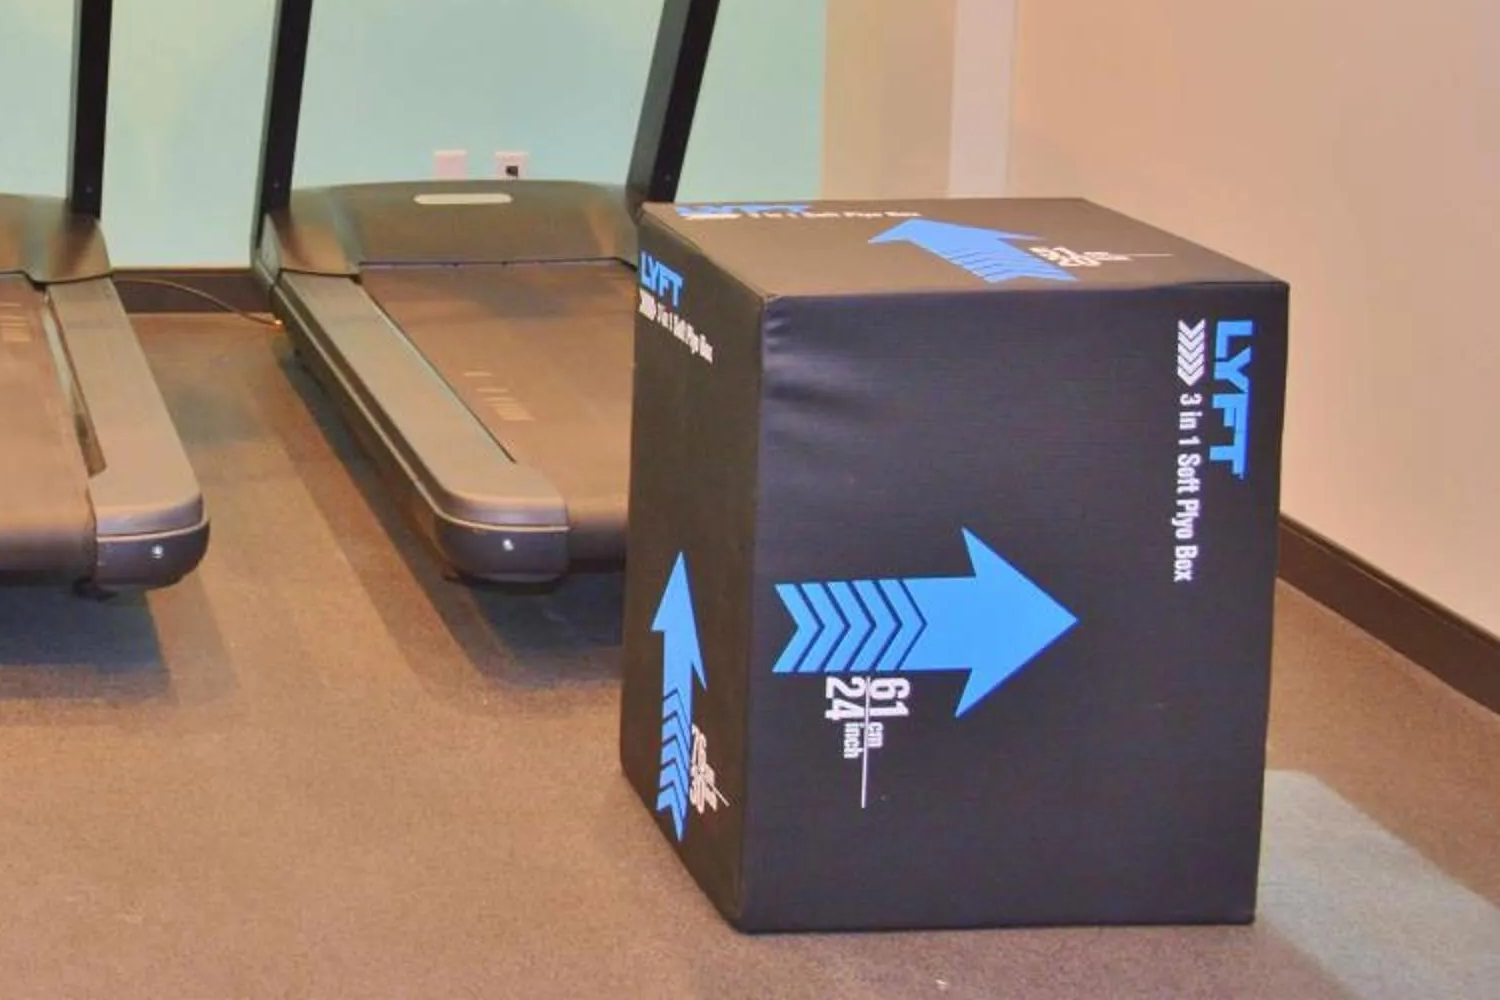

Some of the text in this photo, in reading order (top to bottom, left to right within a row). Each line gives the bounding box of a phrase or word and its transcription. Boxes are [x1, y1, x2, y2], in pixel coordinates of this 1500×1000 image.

[641, 251, 684, 308] LYFT
[1208, 320, 1253, 477] LYFT
[1171, 393, 1203, 582] 3 in 1 Soft Plyo Box
[824, 676, 866, 759] 24 inch
[867, 677, 911, 749] 61 cm
